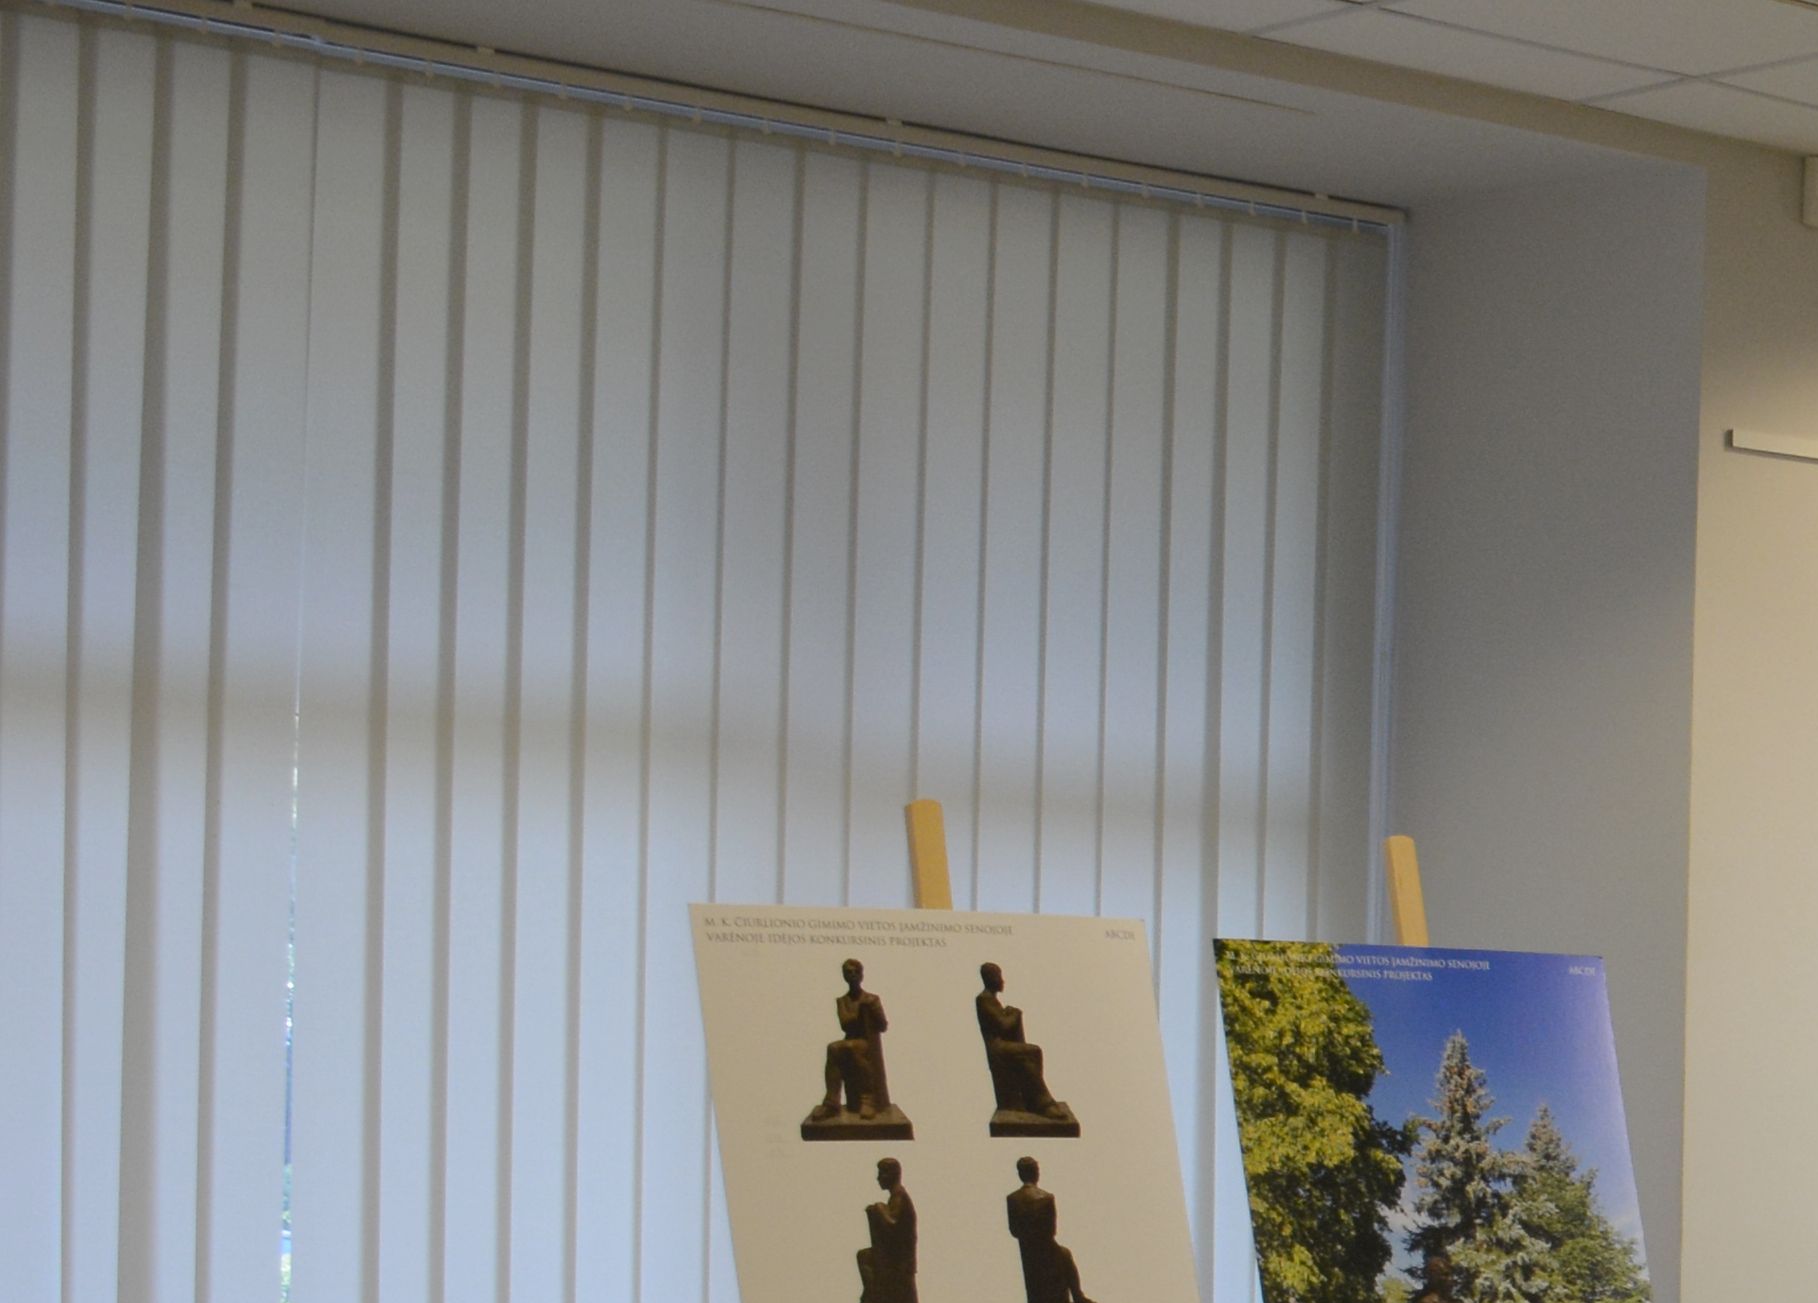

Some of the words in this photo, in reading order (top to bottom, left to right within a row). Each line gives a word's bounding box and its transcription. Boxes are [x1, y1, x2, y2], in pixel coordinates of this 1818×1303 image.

[808, 920, 855, 930] GIMIMO
[857, 921, 896, 931] VIETOS
[964, 924, 1015, 936] SENOJOJE
[810, 935, 886, 946] KONKURSINIS
[889, 937, 947, 948] PROJEKTAS
[1356, 955, 1390, 966] VIETOS
[1448, 960, 1491, 970] SENOJOJE
[1383, 971, 1433, 981] PROJEKTAS
